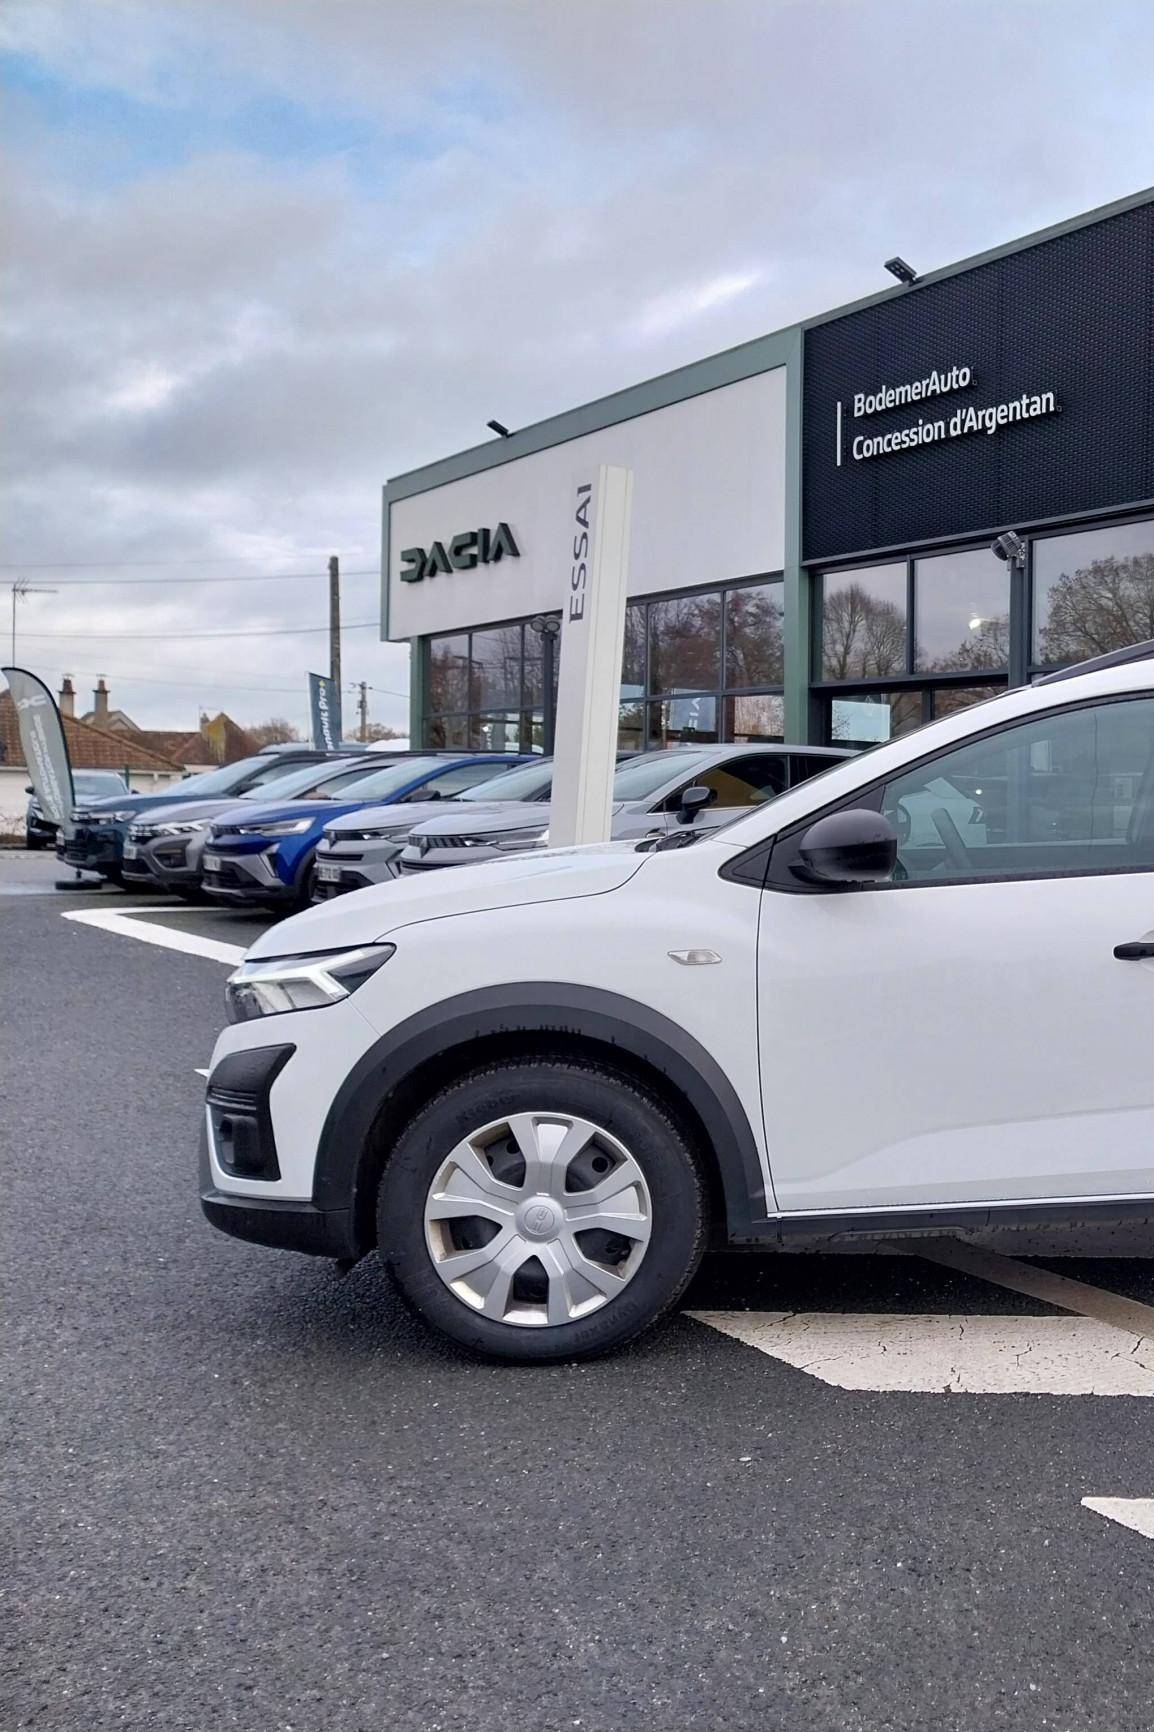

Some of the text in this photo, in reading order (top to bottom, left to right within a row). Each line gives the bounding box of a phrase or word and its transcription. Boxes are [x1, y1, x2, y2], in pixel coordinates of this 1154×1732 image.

[853, 366, 971, 418] BodemerAuto
[852, 391, 1055, 460] Concession d'Argentan
[400, 521, 520, 584] DACIA
[569, 483, 592, 624] ESSAI
[320, 711, 335, 751] enault
